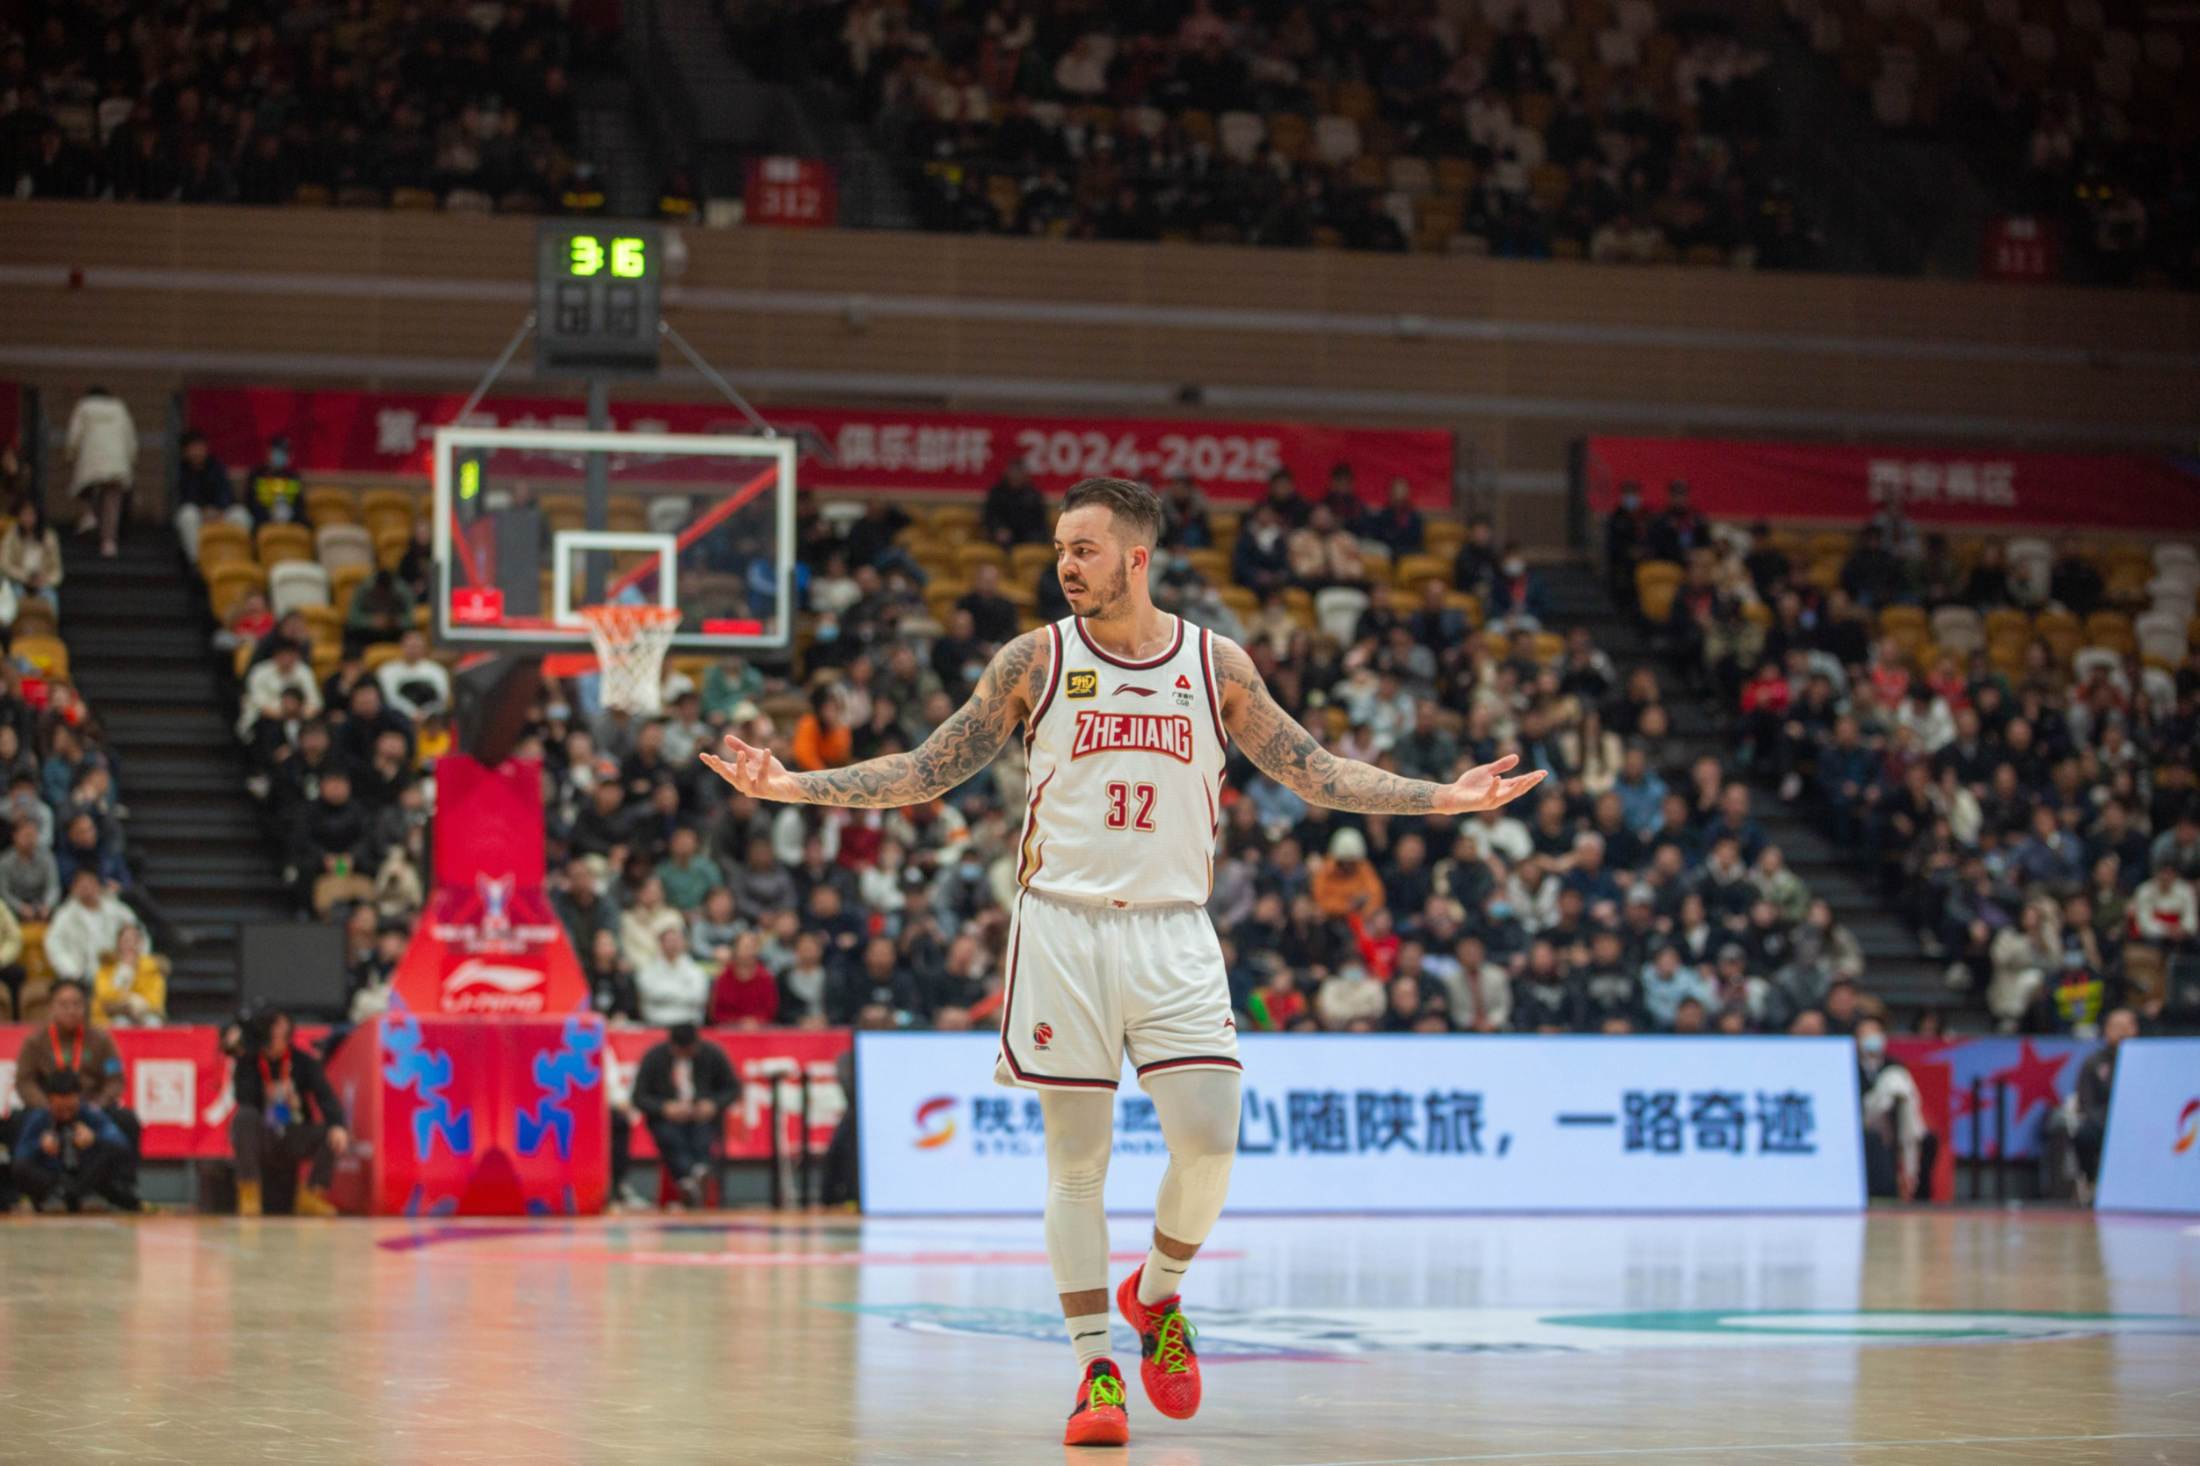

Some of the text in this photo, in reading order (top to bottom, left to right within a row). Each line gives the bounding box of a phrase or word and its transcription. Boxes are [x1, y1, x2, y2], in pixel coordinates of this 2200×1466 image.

[1016, 428, 1280, 481] 2024-2025
[1175, 698, 1190, 707] CGB
[1072, 711, 1192, 763] ZHEJIANG
[1105, 780, 1157, 833] 32
